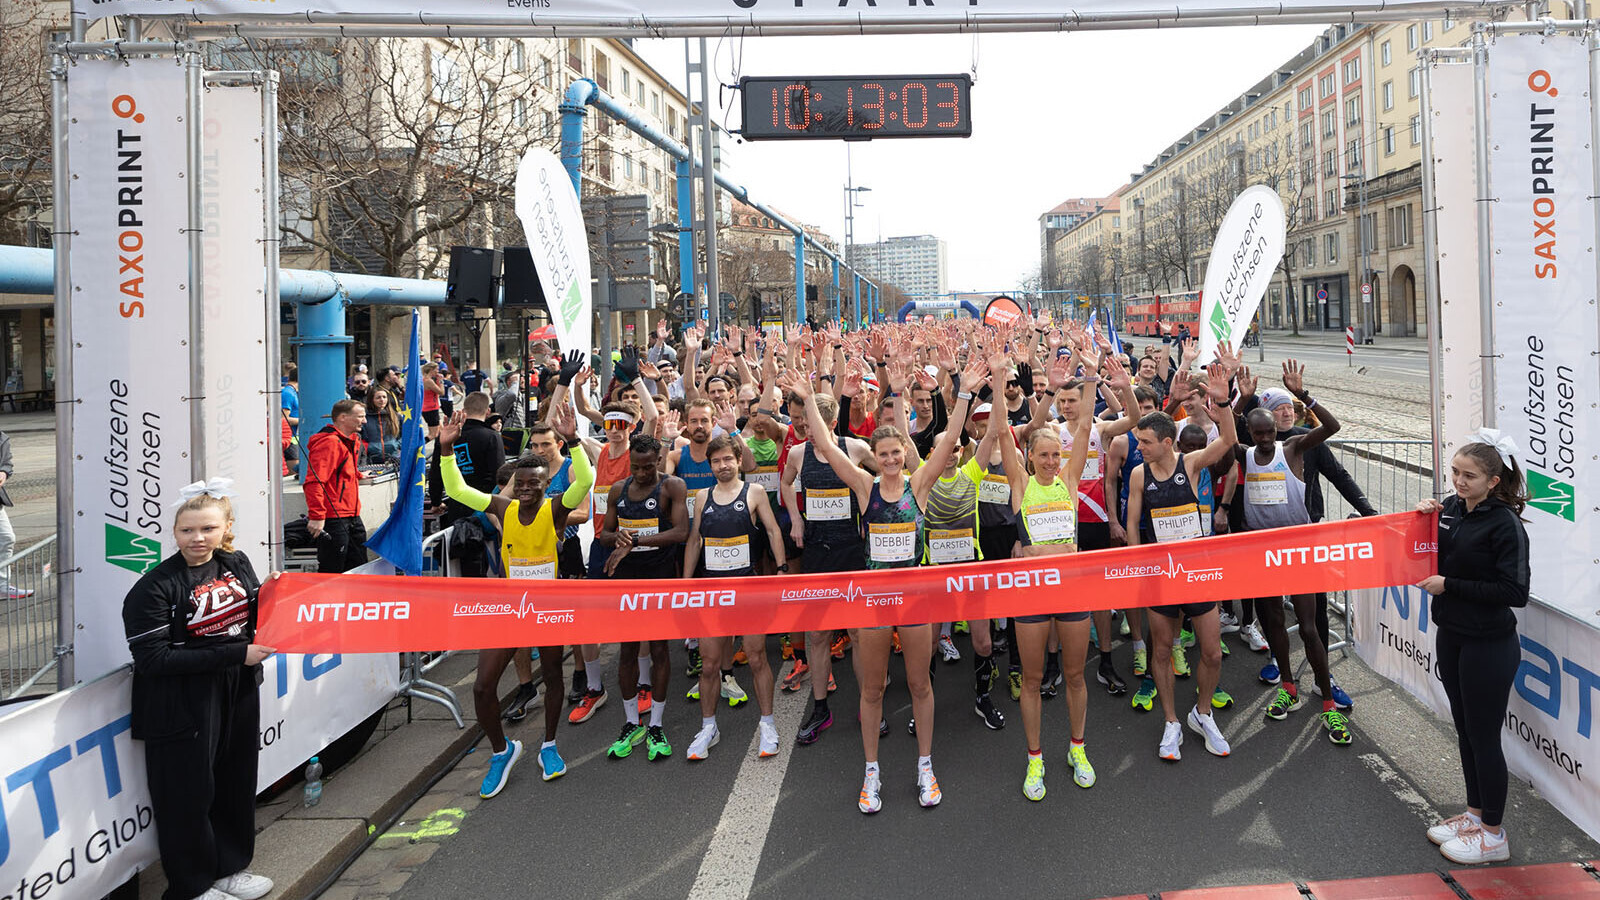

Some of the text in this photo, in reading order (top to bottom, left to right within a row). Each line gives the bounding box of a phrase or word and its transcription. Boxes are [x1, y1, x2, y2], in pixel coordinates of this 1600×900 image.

[771, 82, 960, 131] 10:13:03
[1530, 103, 1557, 279] SAXOPRINT
[117, 129, 145, 318] SAXOPRINT
[1219, 202, 1263, 305] Laufszene
[1227, 236, 1268, 323] Sachsen
[1523, 335, 1547, 470] Laufszene
[1553, 365, 1575, 479] Sachsen
[103, 379, 129, 524] Laufszene
[136, 411, 162, 535] Sachsen
[753, 473, 771, 483] JAN
[979, 481, 1005, 494] MARC
[812, 498, 844, 509] LUKAS
[1030, 513, 1073, 527] DOMENIKA
[1158, 515, 1195, 530] PHILIPP
[875, 536, 910, 547] DEBBIE
[932, 539, 971, 550] CARSTEN
[714, 547, 740, 559] RICO
[1265, 548, 1312, 567] NTT
[525, 567, 552, 577] DANIEL
[1104, 563, 1161, 577] Laufszene
[1187, 571, 1223, 584] Events
[946, 574, 994, 592] NTT
[619, 592, 670, 611] NTT
[781, 586, 839, 599] Laufszene
[866, 595, 904, 607] Events
[297, 603, 346, 622] NTT
[453, 602, 511, 615] Laufszene
[1381, 584, 1433, 634] NT
[536, 612, 575, 624] Events
[1379, 622, 1432, 674] Trusted
[0, 713, 132, 867] TT
[85, 804, 153, 864] Glob
